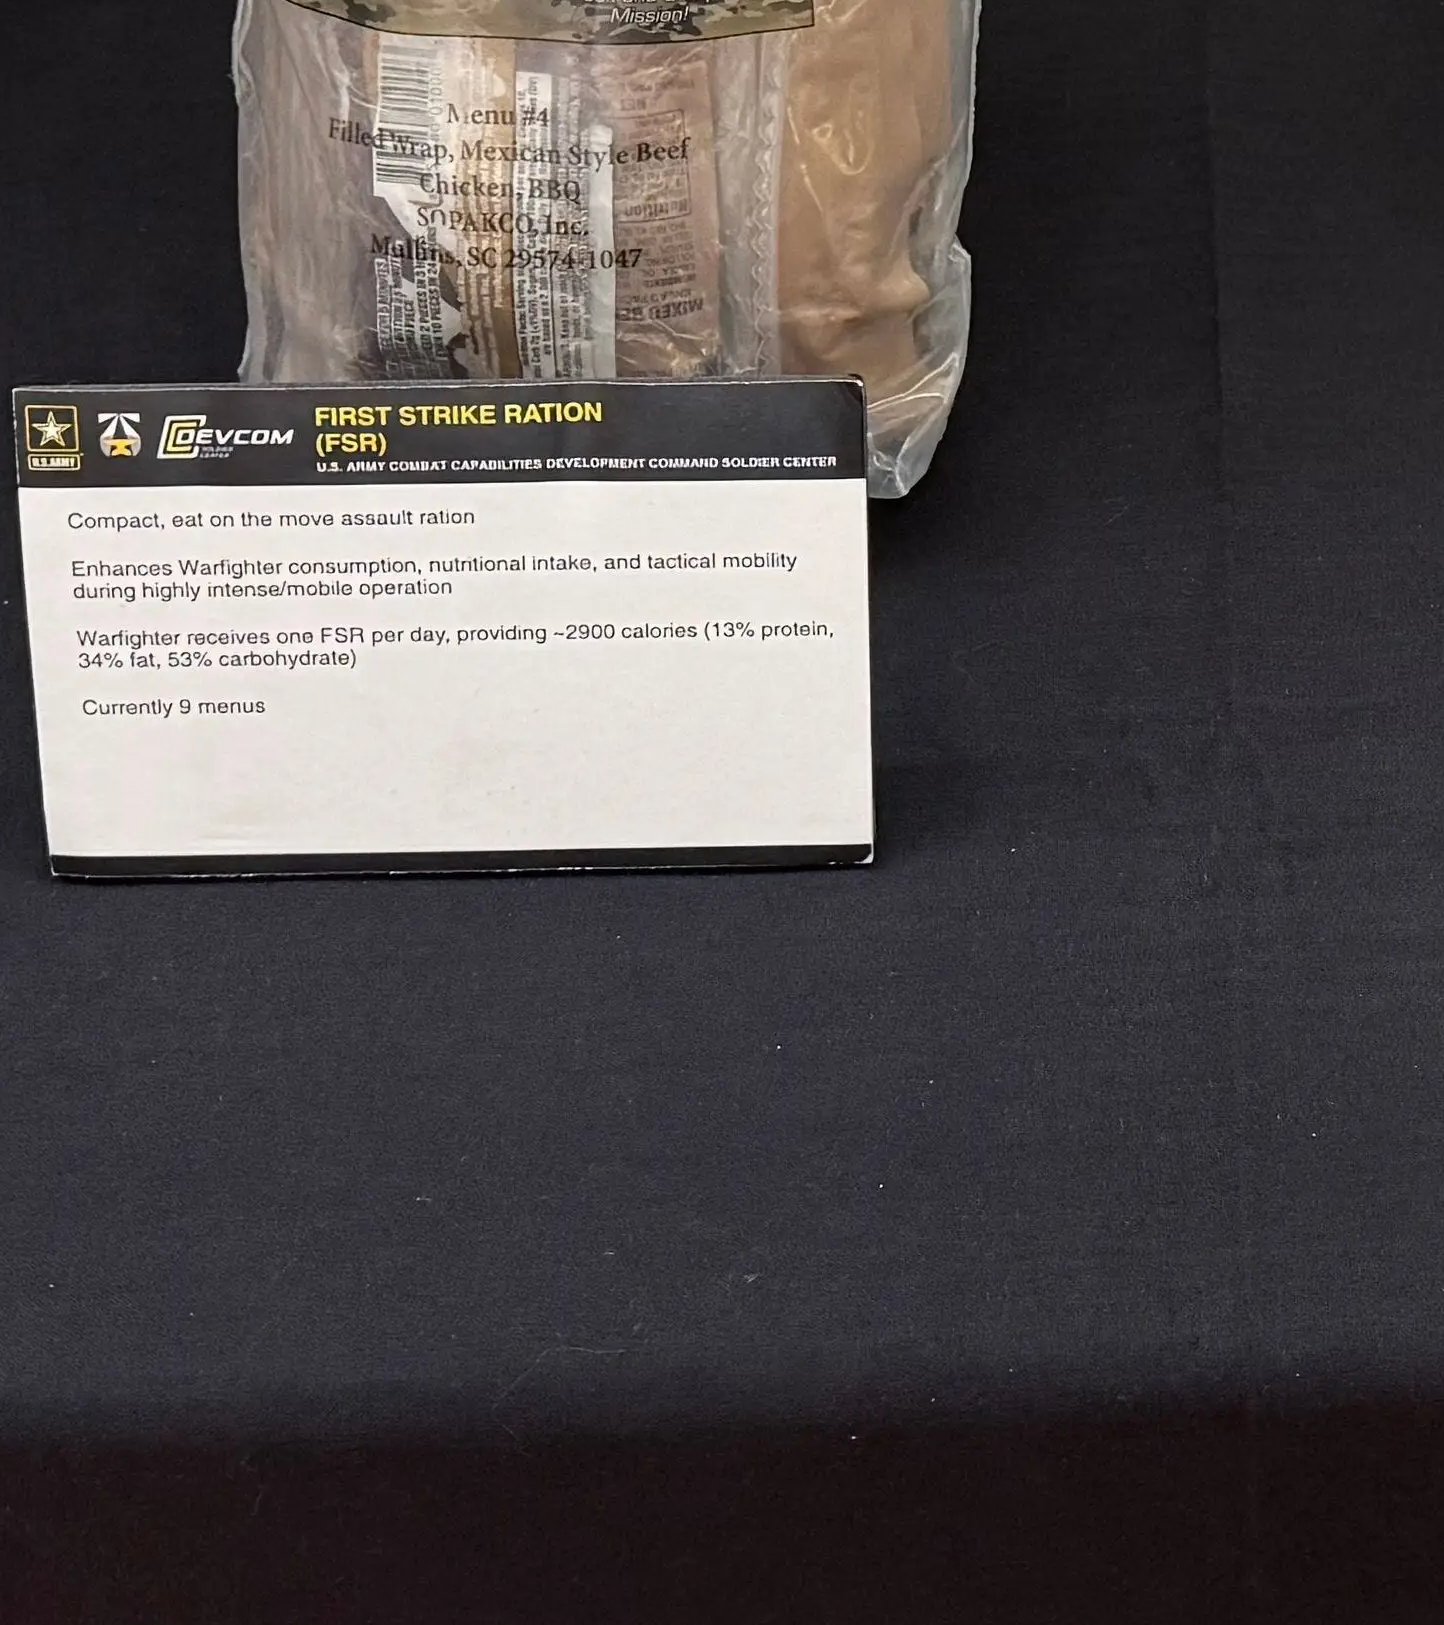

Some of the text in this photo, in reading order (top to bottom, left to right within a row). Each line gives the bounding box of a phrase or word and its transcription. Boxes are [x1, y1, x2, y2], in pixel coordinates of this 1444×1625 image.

[609, 5, 690, 25] Mission!
[447, 102, 550, 127] Menu #4
[460, 139, 560, 164] Mexican
[567, 138, 628, 173] Style
[634, 136, 692, 163] Beef
[419, 171, 581, 204] Chicken, BBQ
[544, 216, 590, 237] Inc.
[468, 247, 500, 268] SC
[314, 401, 603, 427] FIRST STRIKE RATION
[315, 432, 388, 458] (FSR)
[67, 509, 476, 533] Compact, eat on the move assault ration
[76, 619, 835, 650] Warfighter receives one FSR per day, providing ~2900 calories (13% protein,
[77, 647, 357, 671] 34% fat, 53% carbohydrate)
[81, 697, 266, 718] Currently 9 menus
